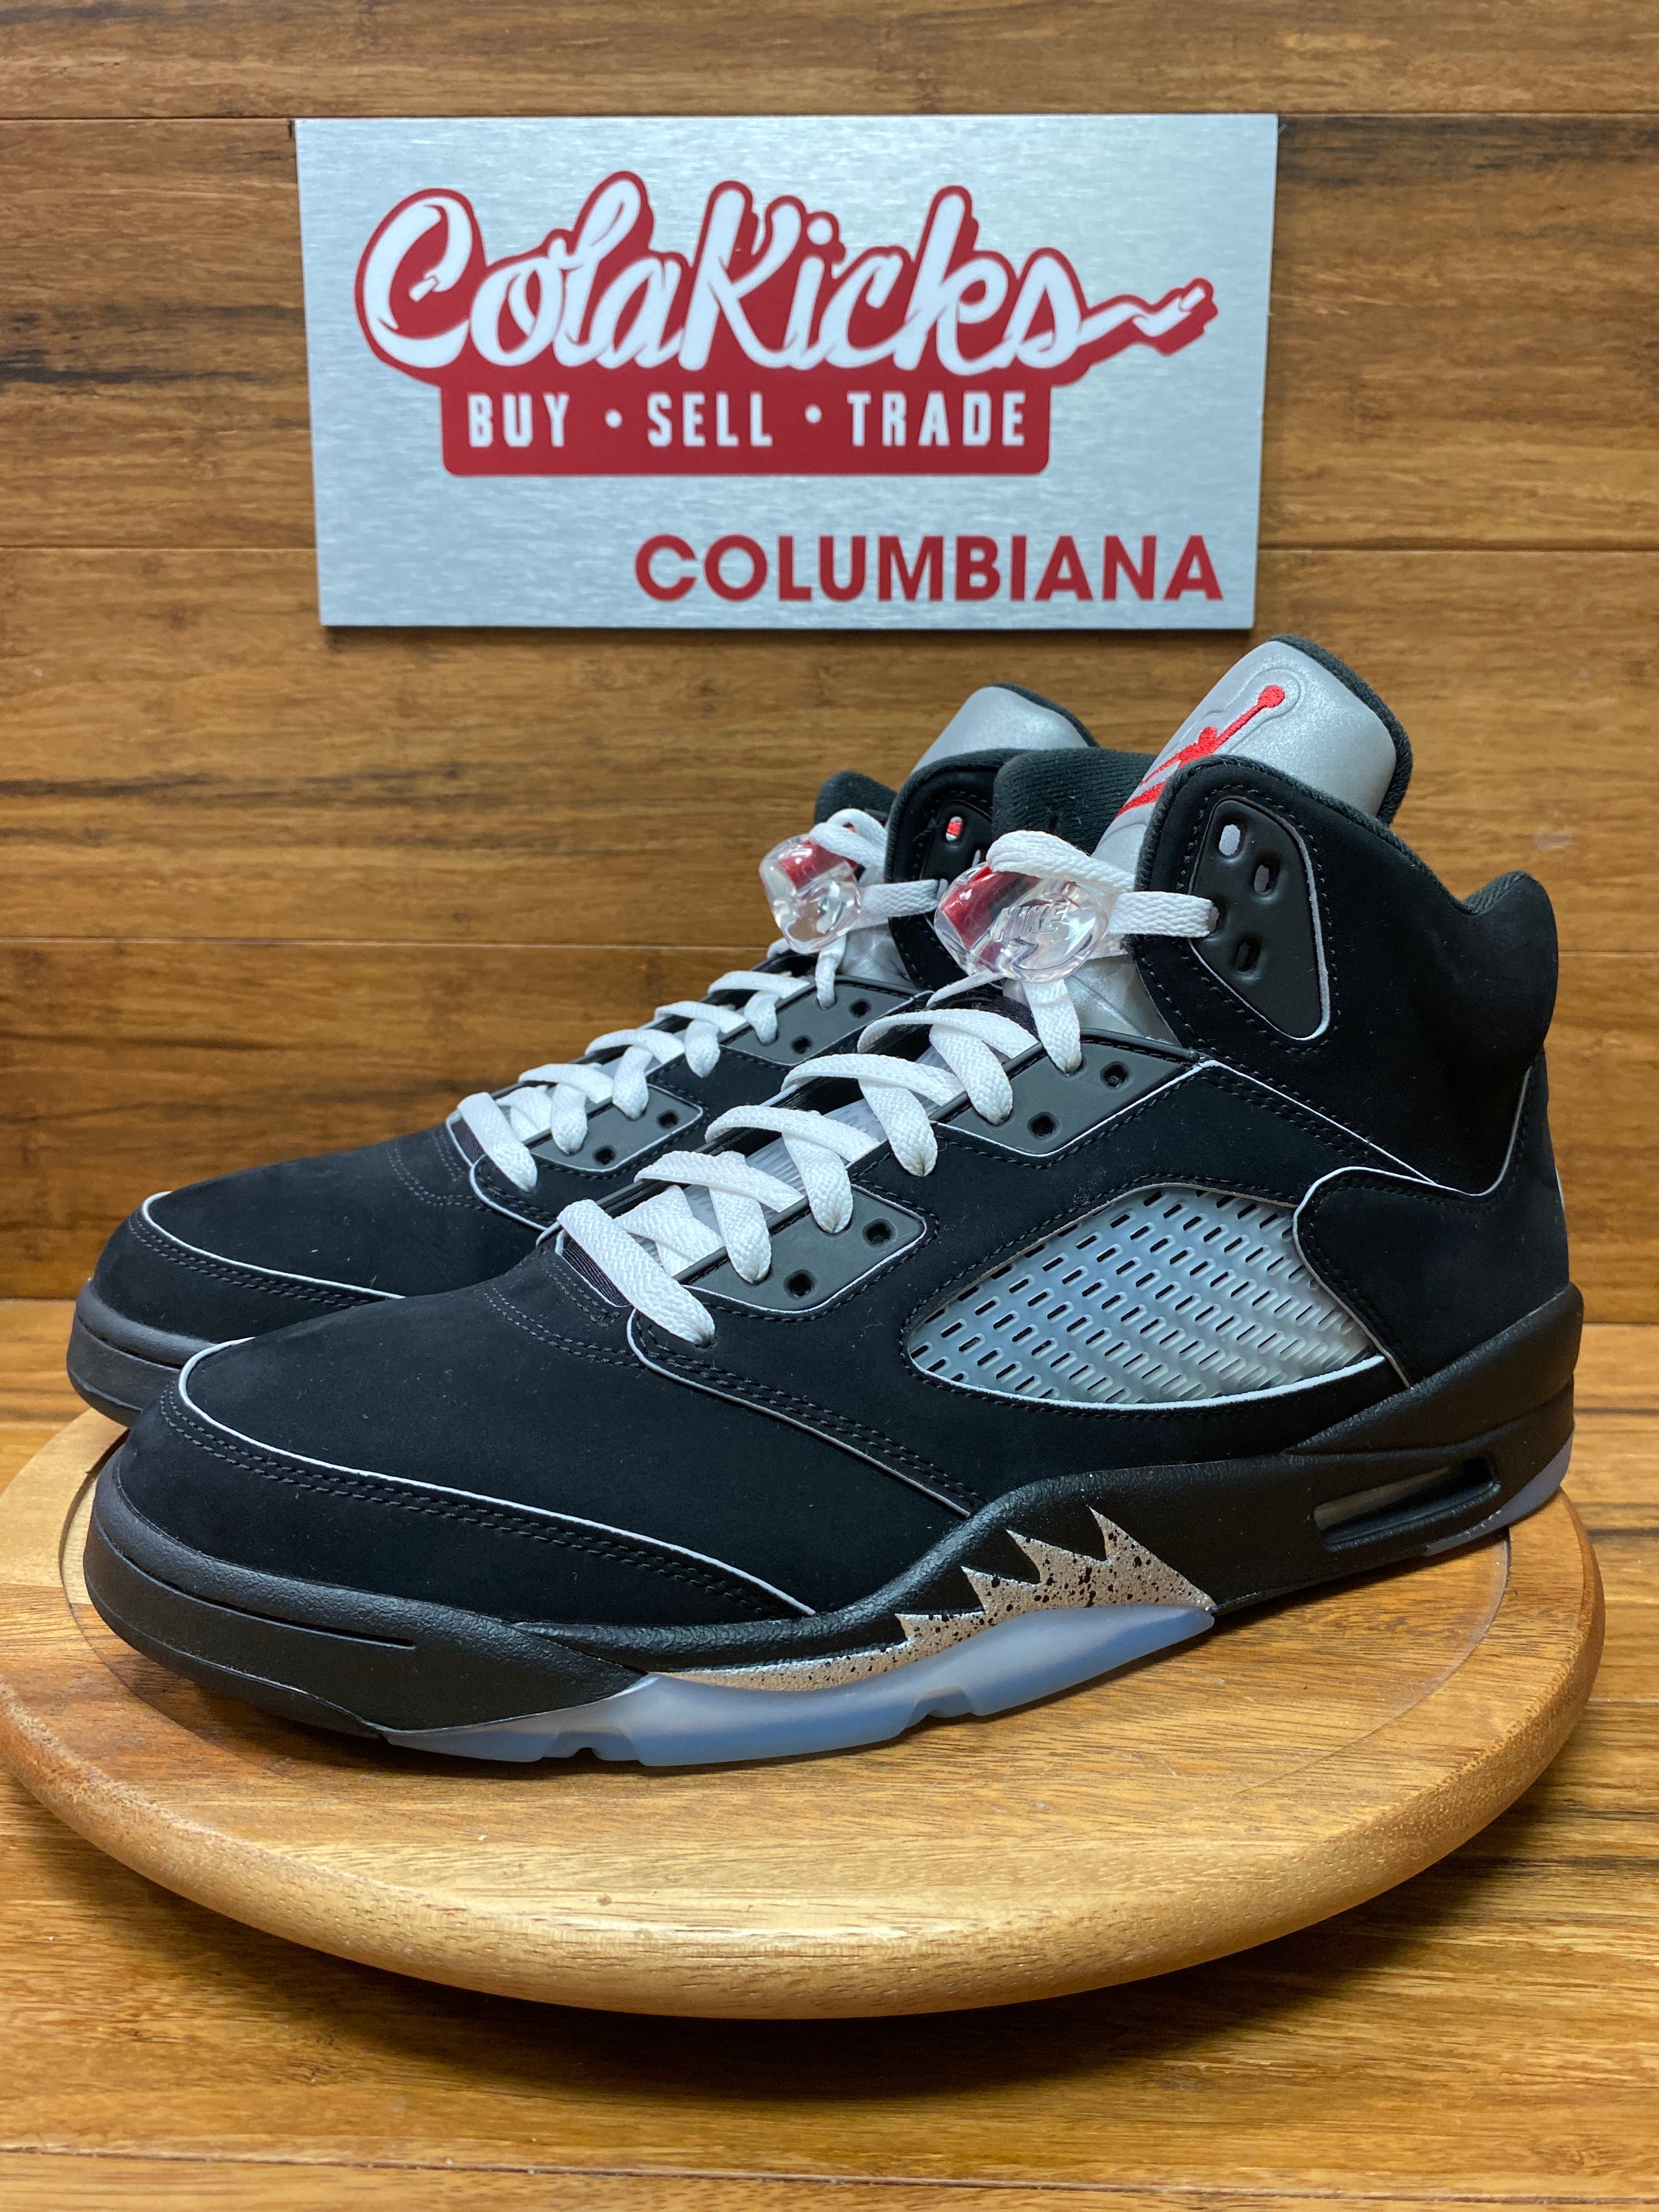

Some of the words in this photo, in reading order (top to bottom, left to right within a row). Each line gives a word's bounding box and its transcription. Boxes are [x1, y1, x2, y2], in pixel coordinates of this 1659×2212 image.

[468, 393, 569, 447] BUY
[647, 393, 772, 447] SELL
[847, 392, 1025, 445] TRADE
[635, 534, 1222, 601] COLUMBIANA
[990, 899, 1070, 942] NIKE
